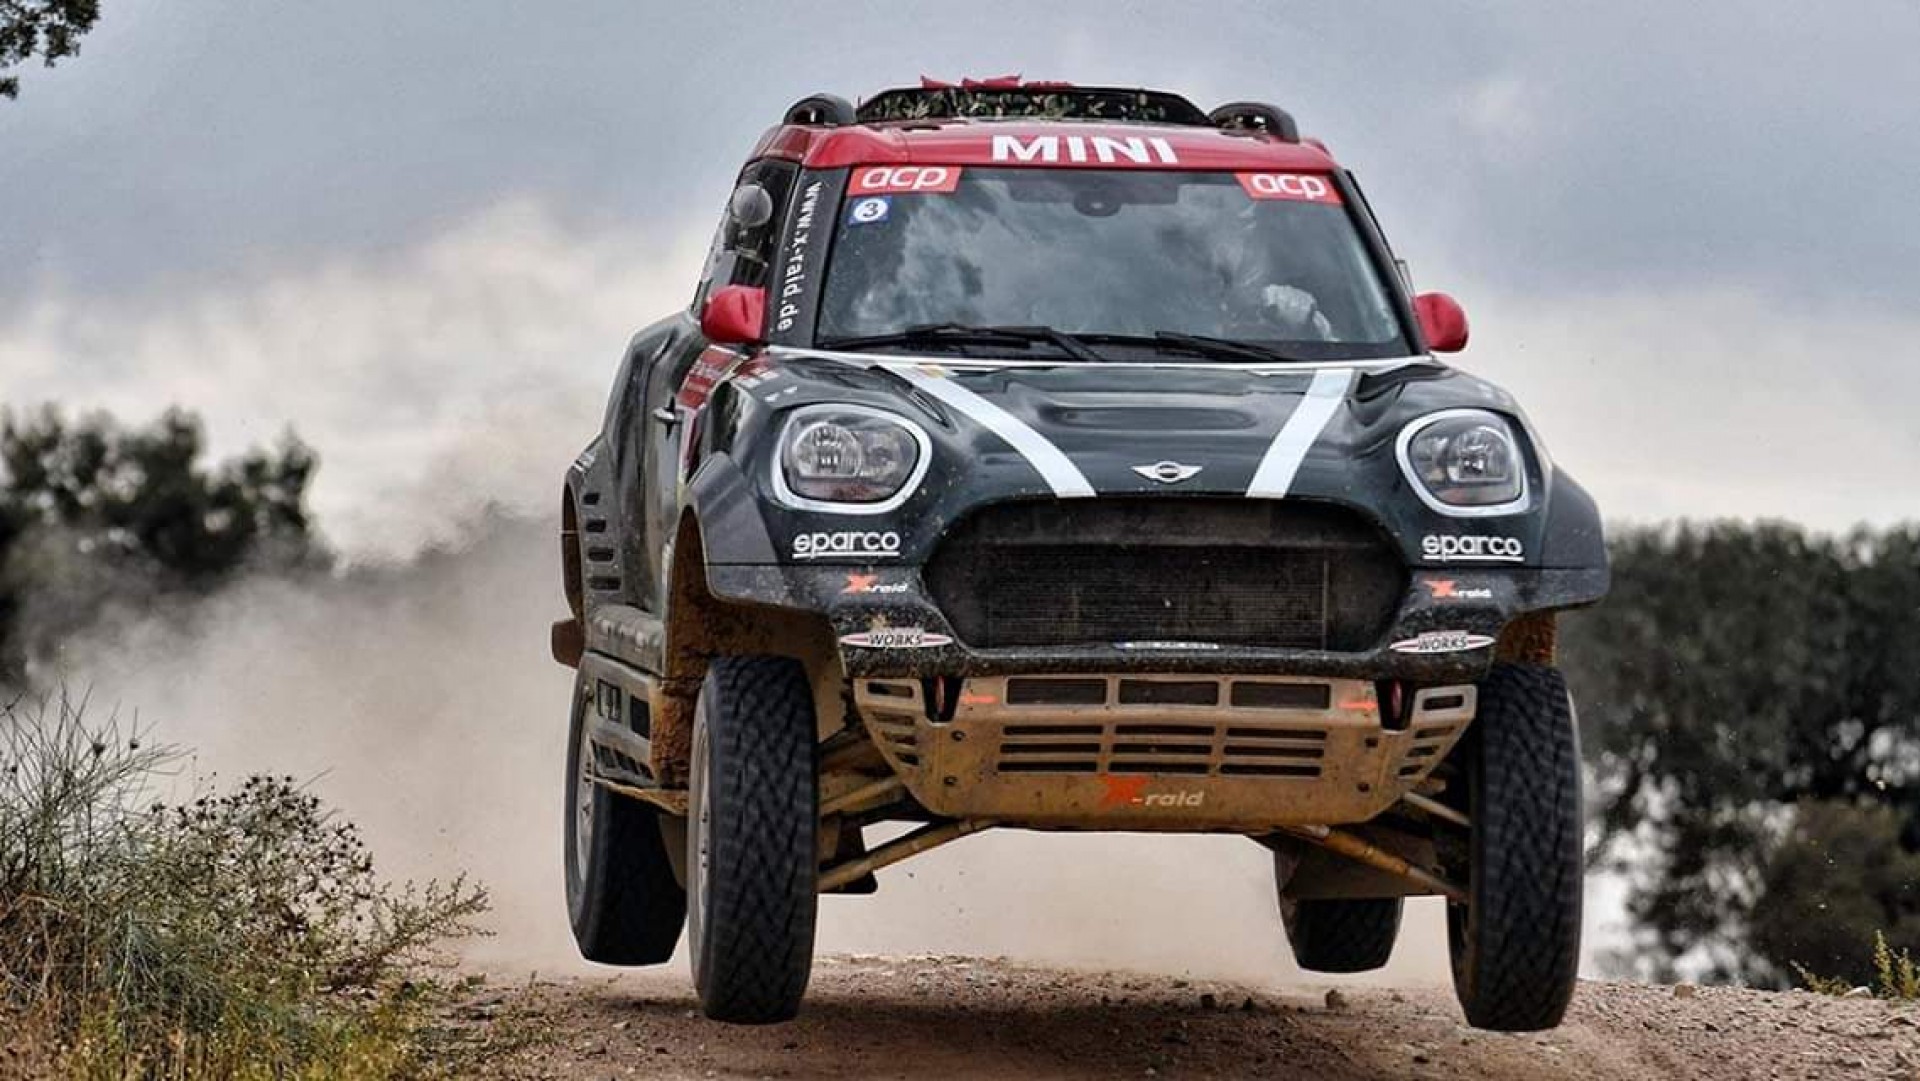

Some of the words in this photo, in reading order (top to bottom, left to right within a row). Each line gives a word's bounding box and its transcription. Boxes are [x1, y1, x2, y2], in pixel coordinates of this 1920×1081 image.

[992, 135, 1178, 163] MINI
[862, 167, 947, 190] acp
[1252, 173, 1327, 199] acp
[862, 202, 879, 218] 3
[777, 181, 823, 332] www.x-raid.de
[792, 531, 901, 559] sparco
[1421, 534, 1524, 561] sparco
[868, 632, 923, 646] WORKS
[1417, 635, 1468, 650] WORKS
